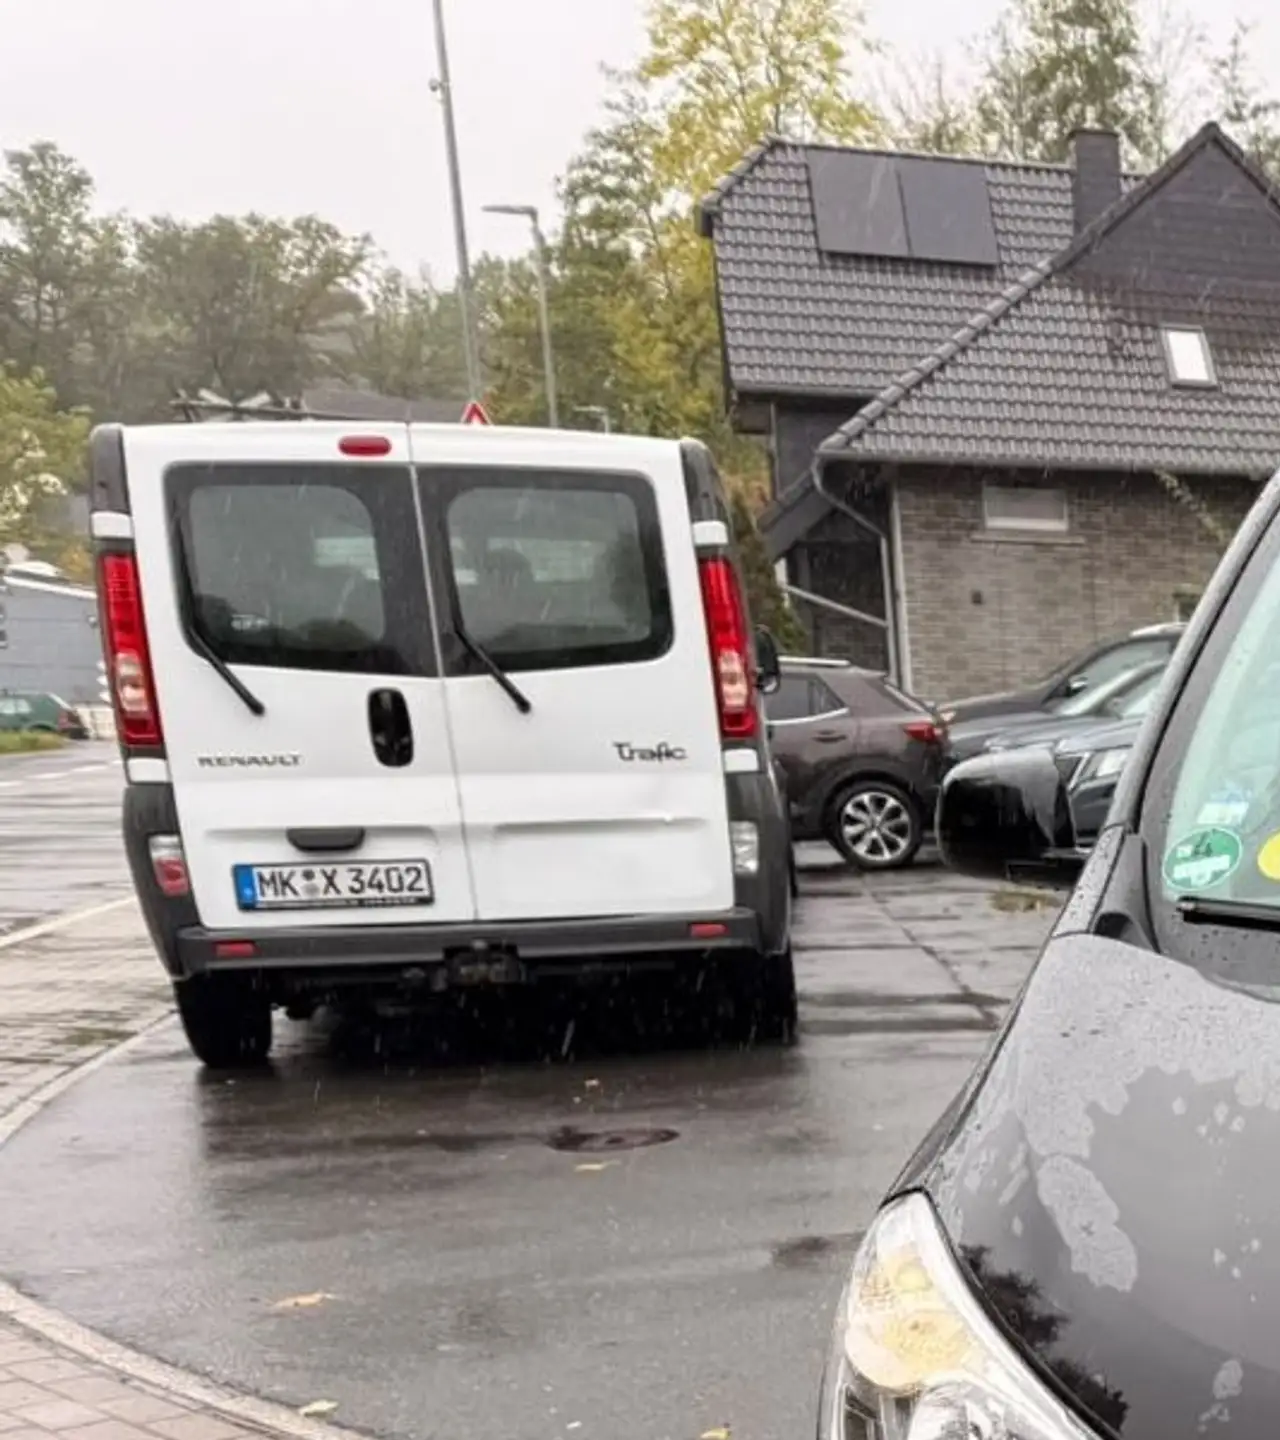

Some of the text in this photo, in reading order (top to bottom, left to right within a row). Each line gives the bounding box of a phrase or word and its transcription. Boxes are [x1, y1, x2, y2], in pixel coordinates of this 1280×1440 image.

[197, 754, 301, 767] RENAULT
[612, 741, 688, 763] Trafic
[256, 866, 423, 898] MK X 3402
